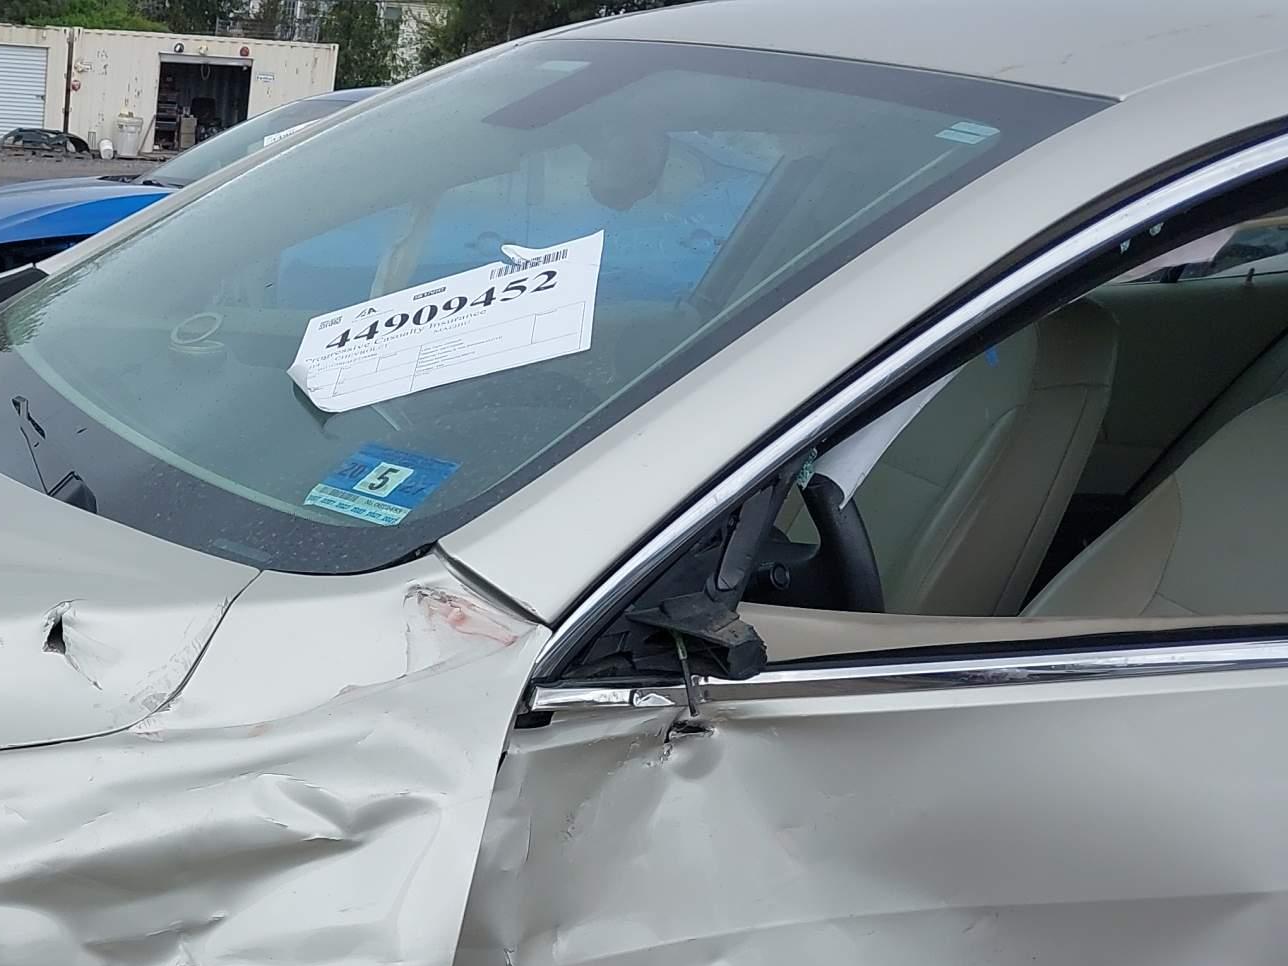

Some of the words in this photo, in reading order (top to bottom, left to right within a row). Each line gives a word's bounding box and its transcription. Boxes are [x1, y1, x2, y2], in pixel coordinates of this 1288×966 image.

[325, 270, 558, 349] 44909452
[429, 308, 487, 329] Insurance
[368, 467, 401, 491] 5
